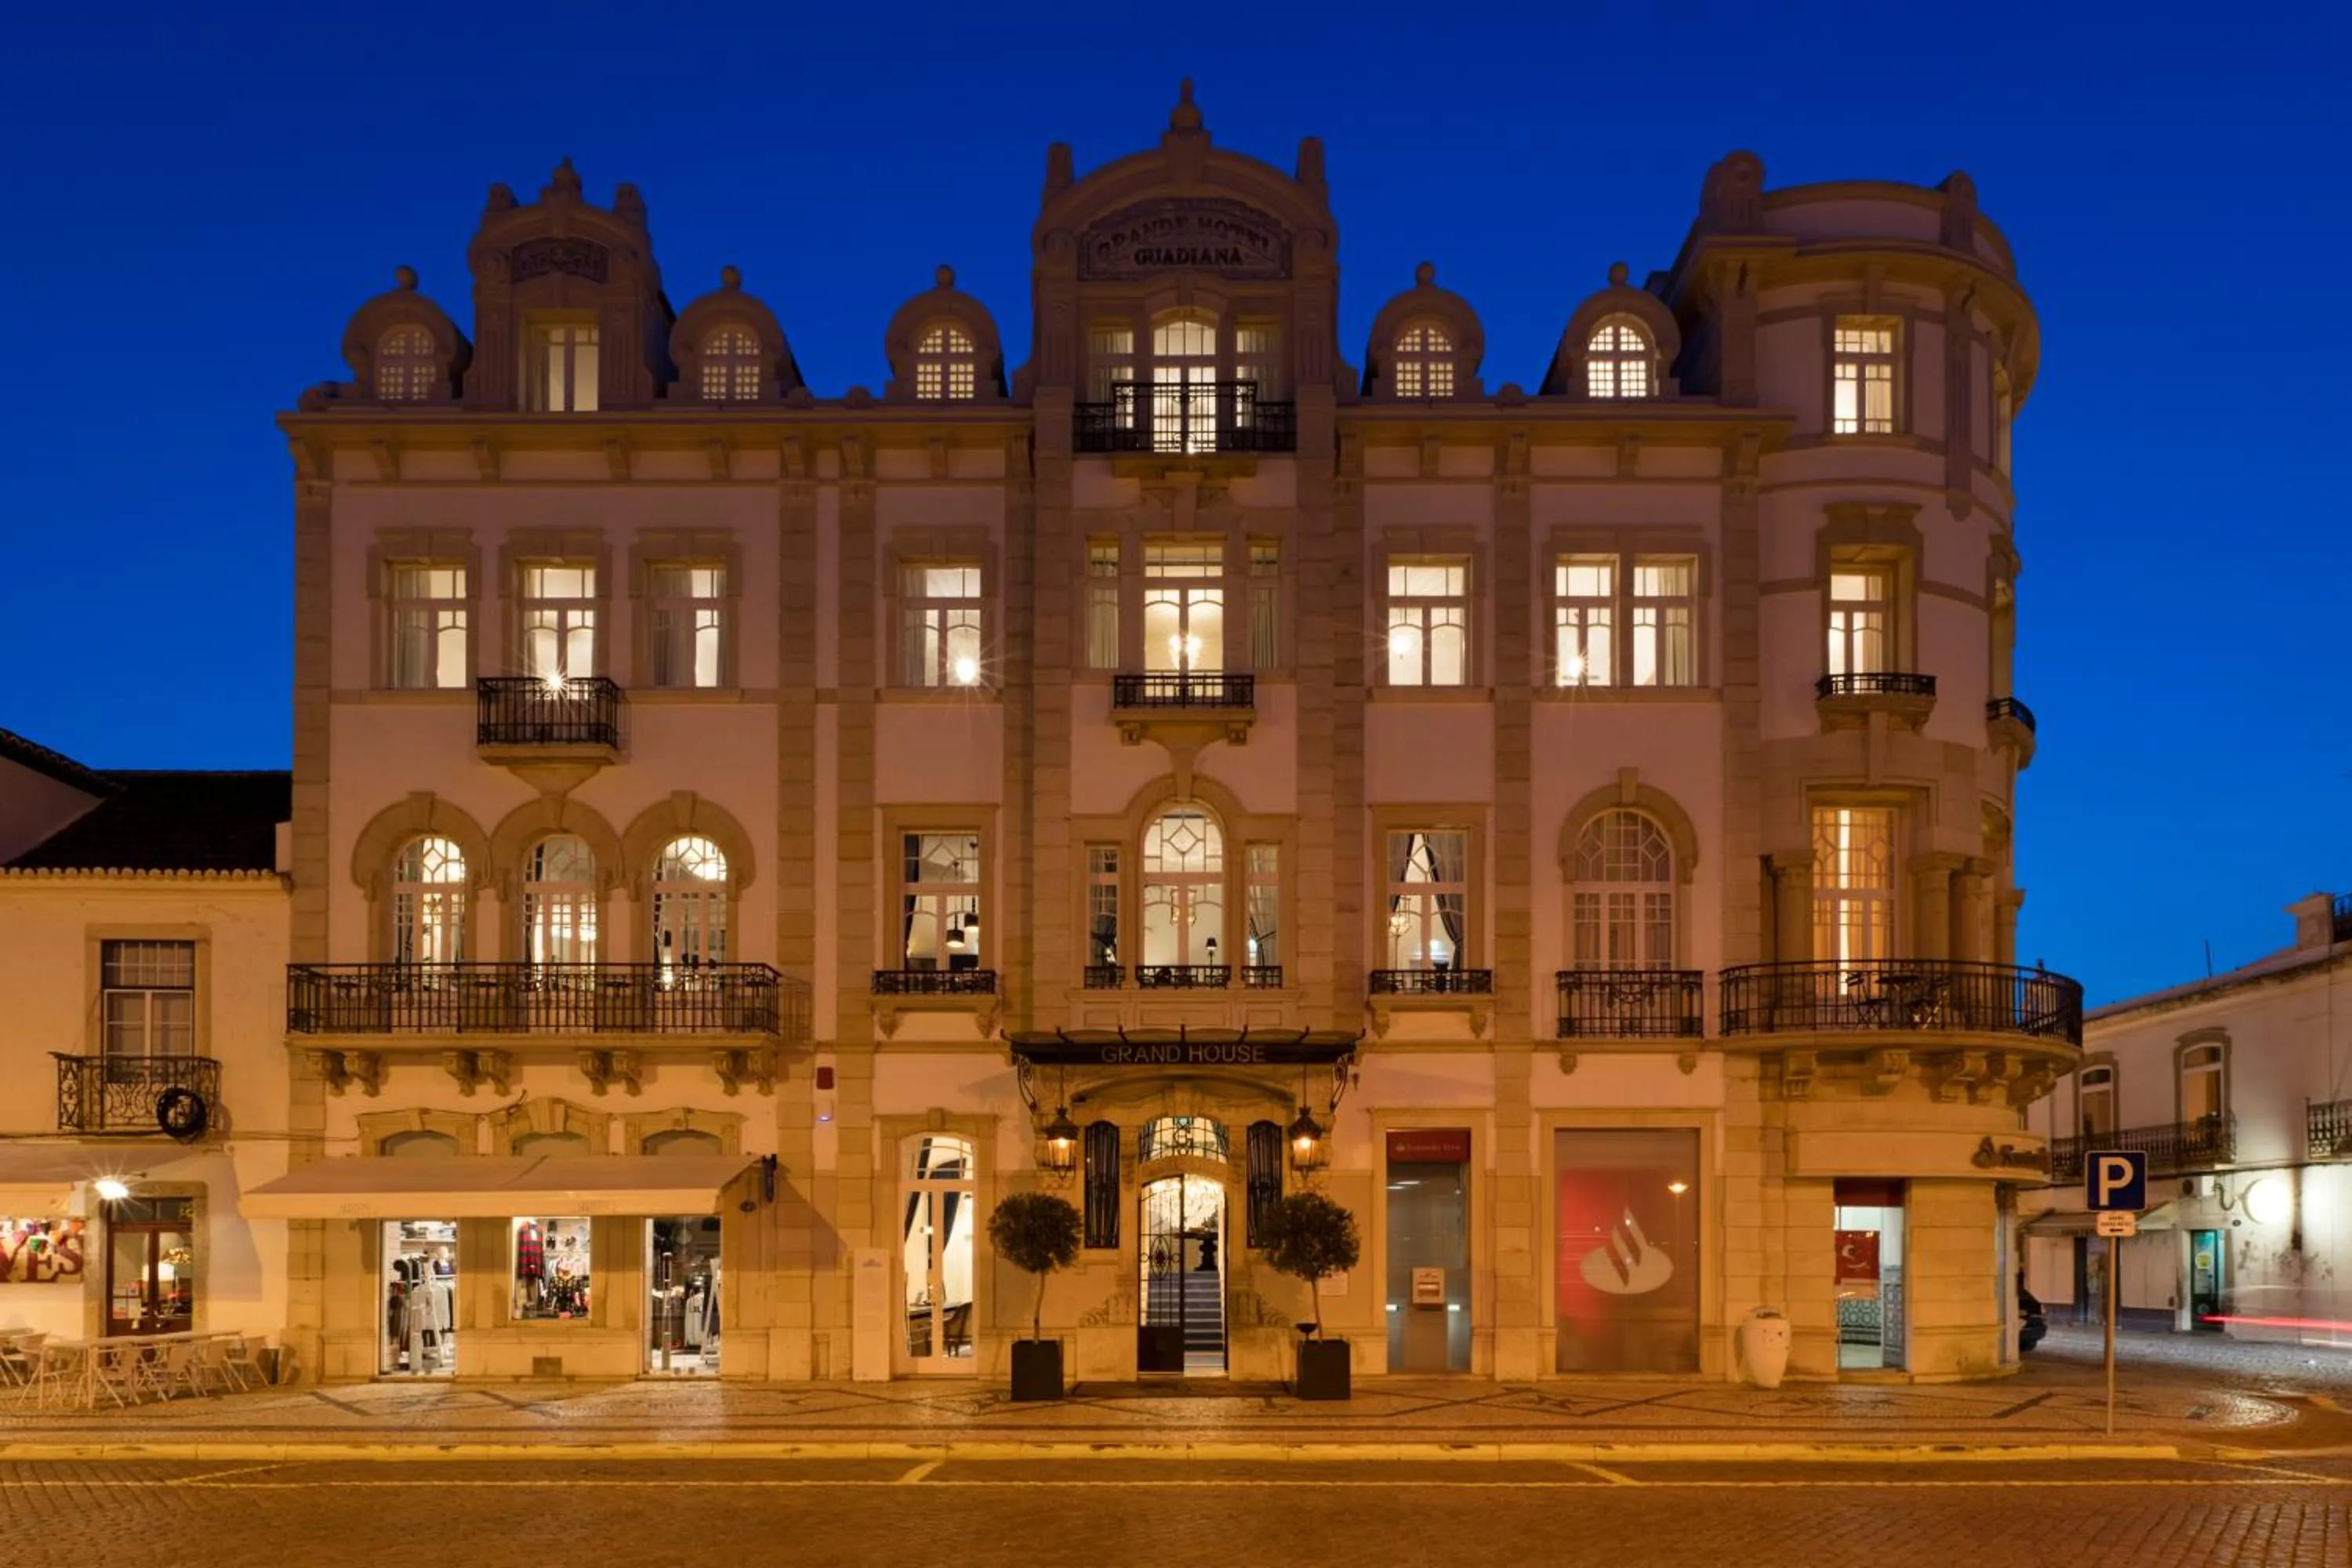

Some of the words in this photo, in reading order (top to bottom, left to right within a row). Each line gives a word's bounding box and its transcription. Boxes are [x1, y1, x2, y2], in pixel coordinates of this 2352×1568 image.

[1097, 215, 1190, 258] GRANDE
[1134, 247, 1243, 265] GUADIANA
[1101, 1044, 1181, 1063] GRAND
[1189, 1044, 1266, 1063] HOUSE
[2099, 1156, 2133, 1207] P
